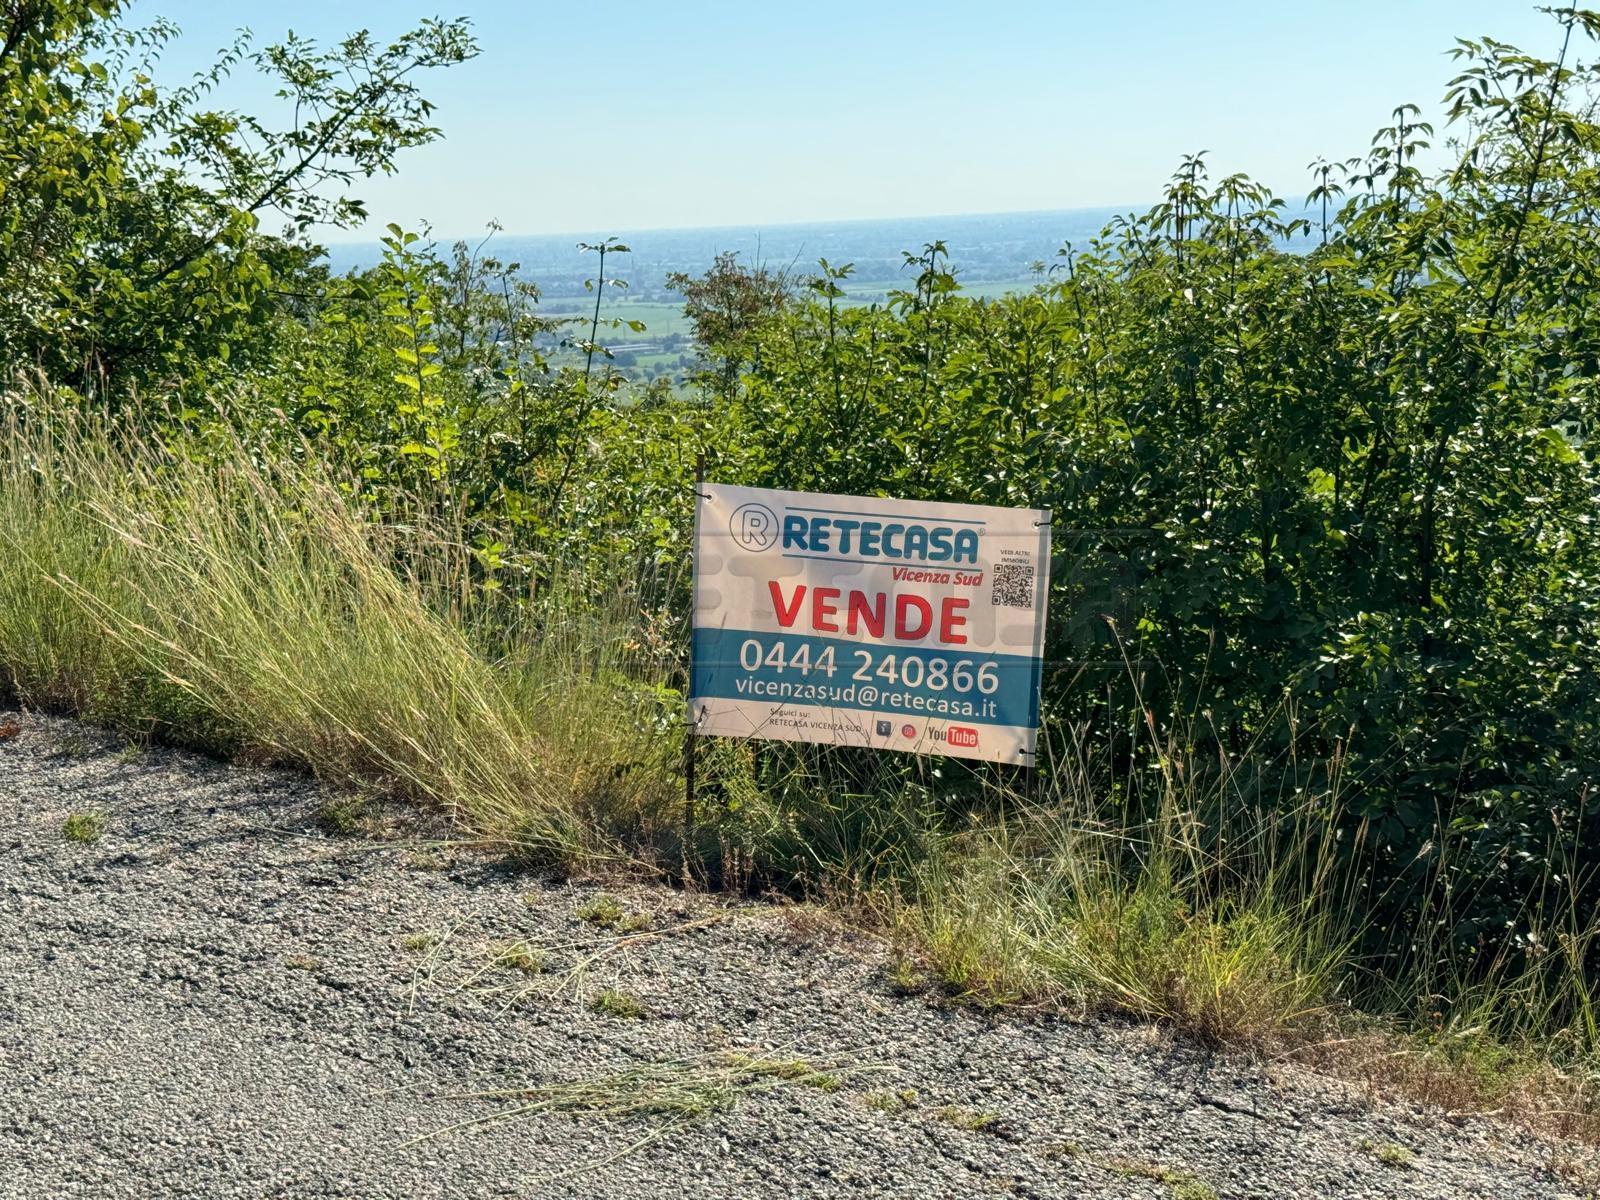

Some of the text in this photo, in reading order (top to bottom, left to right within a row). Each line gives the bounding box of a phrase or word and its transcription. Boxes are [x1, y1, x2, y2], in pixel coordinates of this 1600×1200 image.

[892, 567, 984, 587] Vicenza Sud
[768, 580, 970, 645] VENDE
[740, 639, 999, 694] 0444 240866
[735, 675, 997, 718] vicenzasud@retecasa.it
[770, 707, 797, 717] Seguici
[769, 718, 861, 733] RETECASA VICENZA SUD
